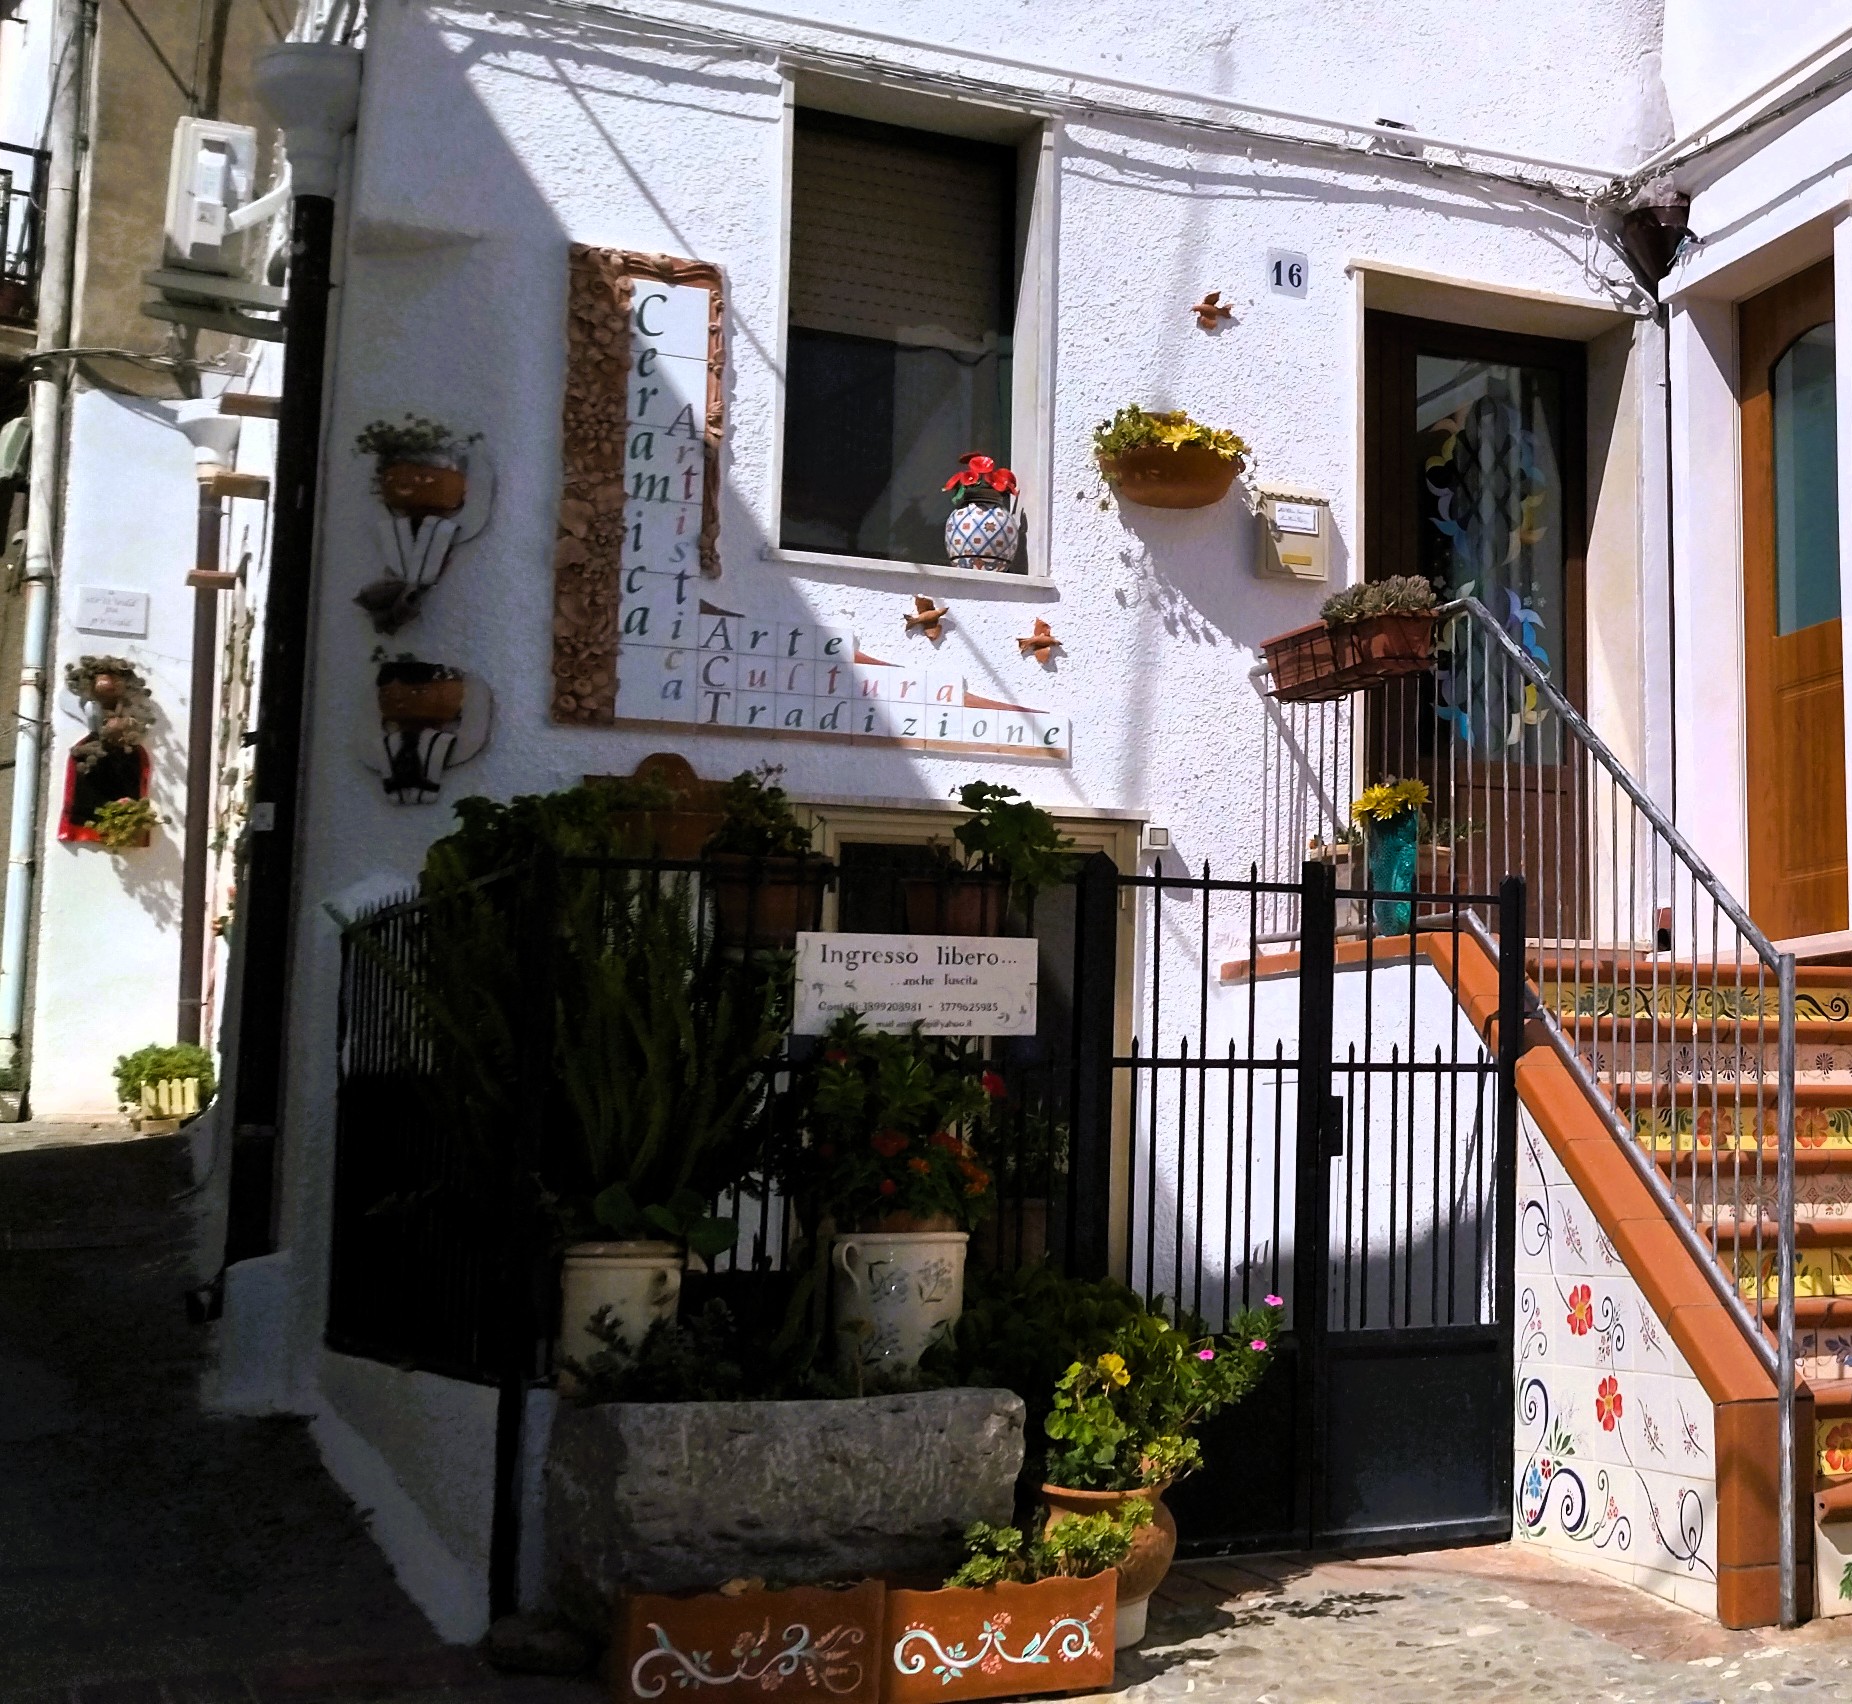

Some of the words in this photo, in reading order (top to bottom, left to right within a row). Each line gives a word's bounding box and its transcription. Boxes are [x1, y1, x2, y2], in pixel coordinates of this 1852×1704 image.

[1272, 259, 1302, 288] 16
[623, 293, 671, 638] Ceramica
[660, 403, 699, 702] Artistica
[700, 616, 843, 656] Arte
[702, 654, 955, 704] Cultura
[702, 691, 1061, 747] Tradizione
[821, 943, 919, 971] Ingresso
[937, 945, 1018, 966] libero...
